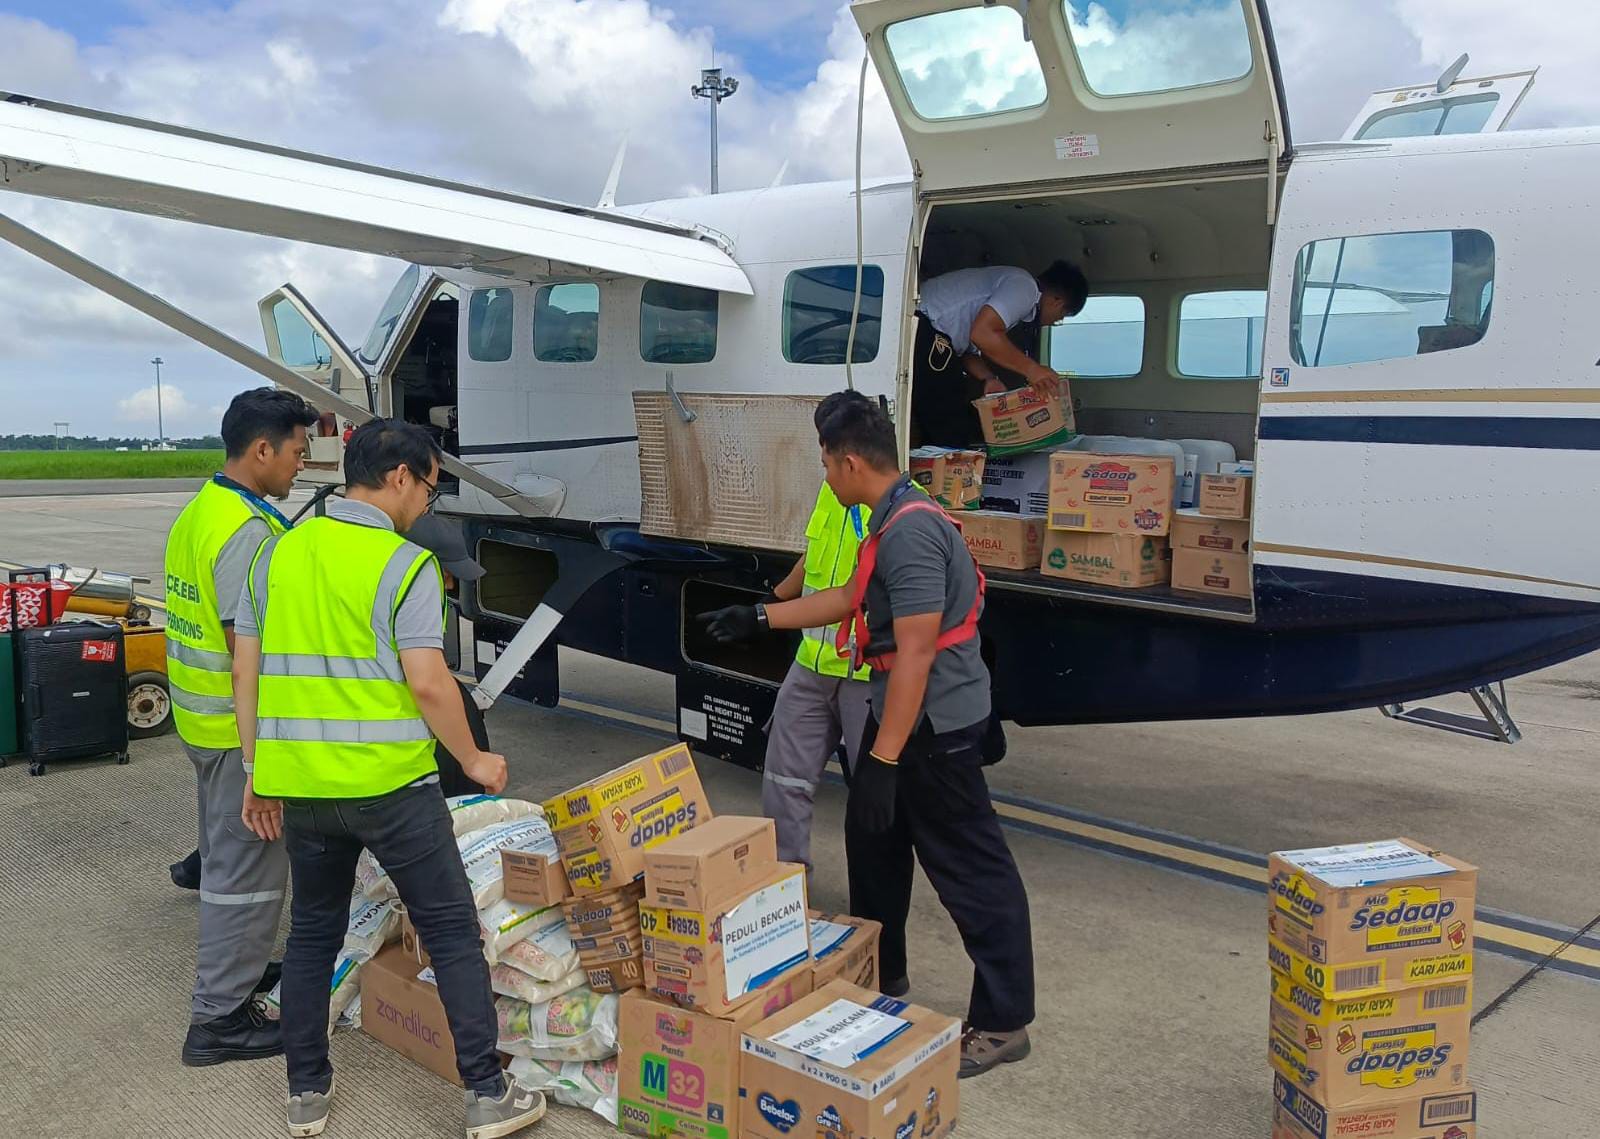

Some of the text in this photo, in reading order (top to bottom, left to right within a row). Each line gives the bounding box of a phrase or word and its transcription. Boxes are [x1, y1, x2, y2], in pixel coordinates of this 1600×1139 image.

[1081, 468, 1137, 482] Sedaap
[964, 535, 1004, 551] SAMBAL
[1070, 552, 1115, 570] SAMBAL
[167, 574, 200, 604] ÇEEBİ
[601, 781, 625, 800] AYAM
[623, 774, 643, 793] KARI
[631, 801, 697, 847] Sedaap
[567, 858, 612, 882] Sedaap
[1269, 877, 1326, 917] Sedaap
[1364, 894, 1389, 906] Mie
[571, 906, 613, 926] Sedaap
[640, 911, 657, 932] 40
[725, 900, 802, 945] PEDULI BENCANA
[1349, 899, 1456, 931] Sedaap
[1397, 921, 1434, 937] Instant
[618, 943, 627, 954] 9
[1311, 944, 1321, 957] 9
[621, 961, 638, 979] 40
[1304, 963, 1325, 989] 40
[1409, 959, 1466, 978] KARI AYAM
[1336, 998, 1394, 1017] KARI AYAM
[376, 997, 441, 1049] zandilac
[793, 1008, 870, 1052] PEDULI BENCANA
[661, 1044, 685, 1058] Pants
[754, 1044, 777, 1060] BARU!
[1371, 1039, 1407, 1052] Instant
[1346, 1044, 1453, 1074] Sedaap
[643, 1059, 700, 1100] M 32
[826, 1073, 840, 1085] 900
[1414, 1067, 1438, 1079] Mie
[760, 1099, 795, 1124] Bebelac
[822, 1110, 841, 1124] Nutri
[1298, 1097, 1322, 1131] 20057
[1335, 1121, 1371, 1135] SPESIAL
[1372, 1117, 1396, 1129] KARI
